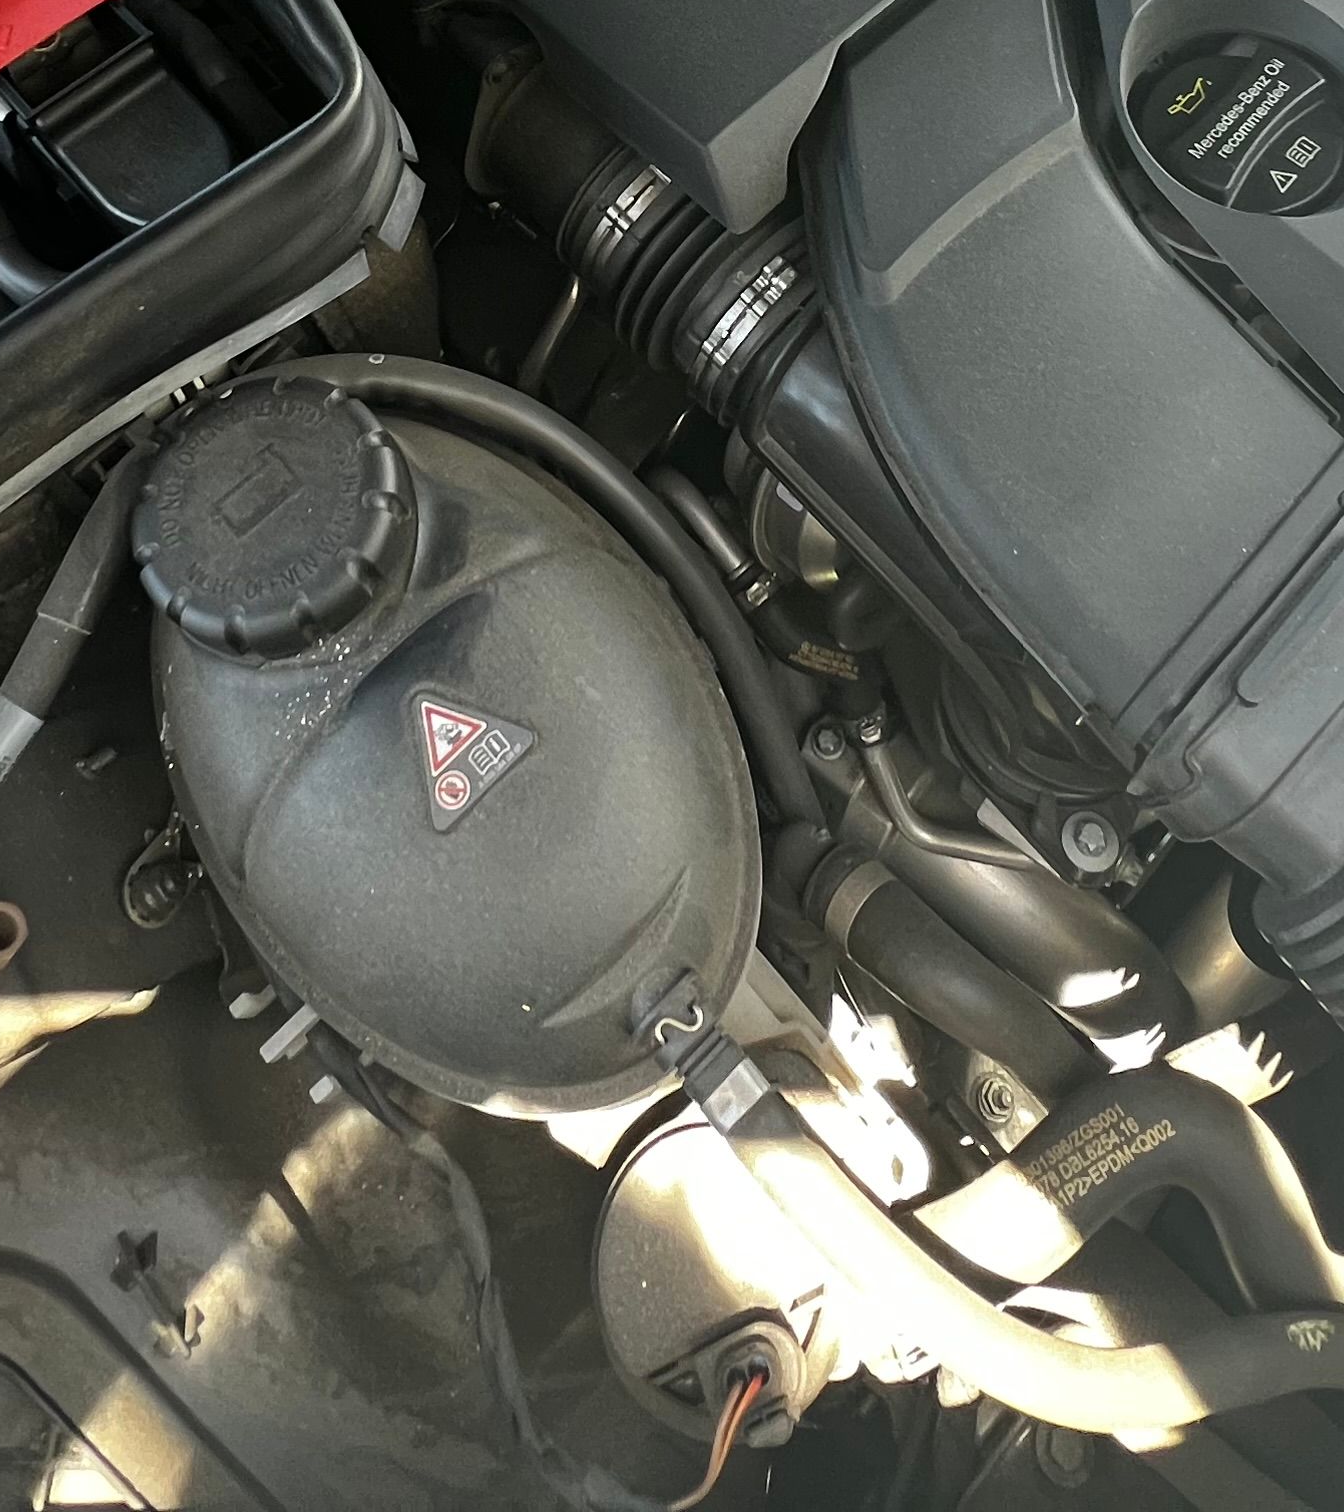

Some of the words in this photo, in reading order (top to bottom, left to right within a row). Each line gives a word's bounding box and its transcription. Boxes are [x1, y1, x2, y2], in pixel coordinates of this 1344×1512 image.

[1187, 75, 1272, 159] Mercedes-Benz
[1264, 58, 1286, 76] Oil
[1217, 80, 1291, 159] recommended
